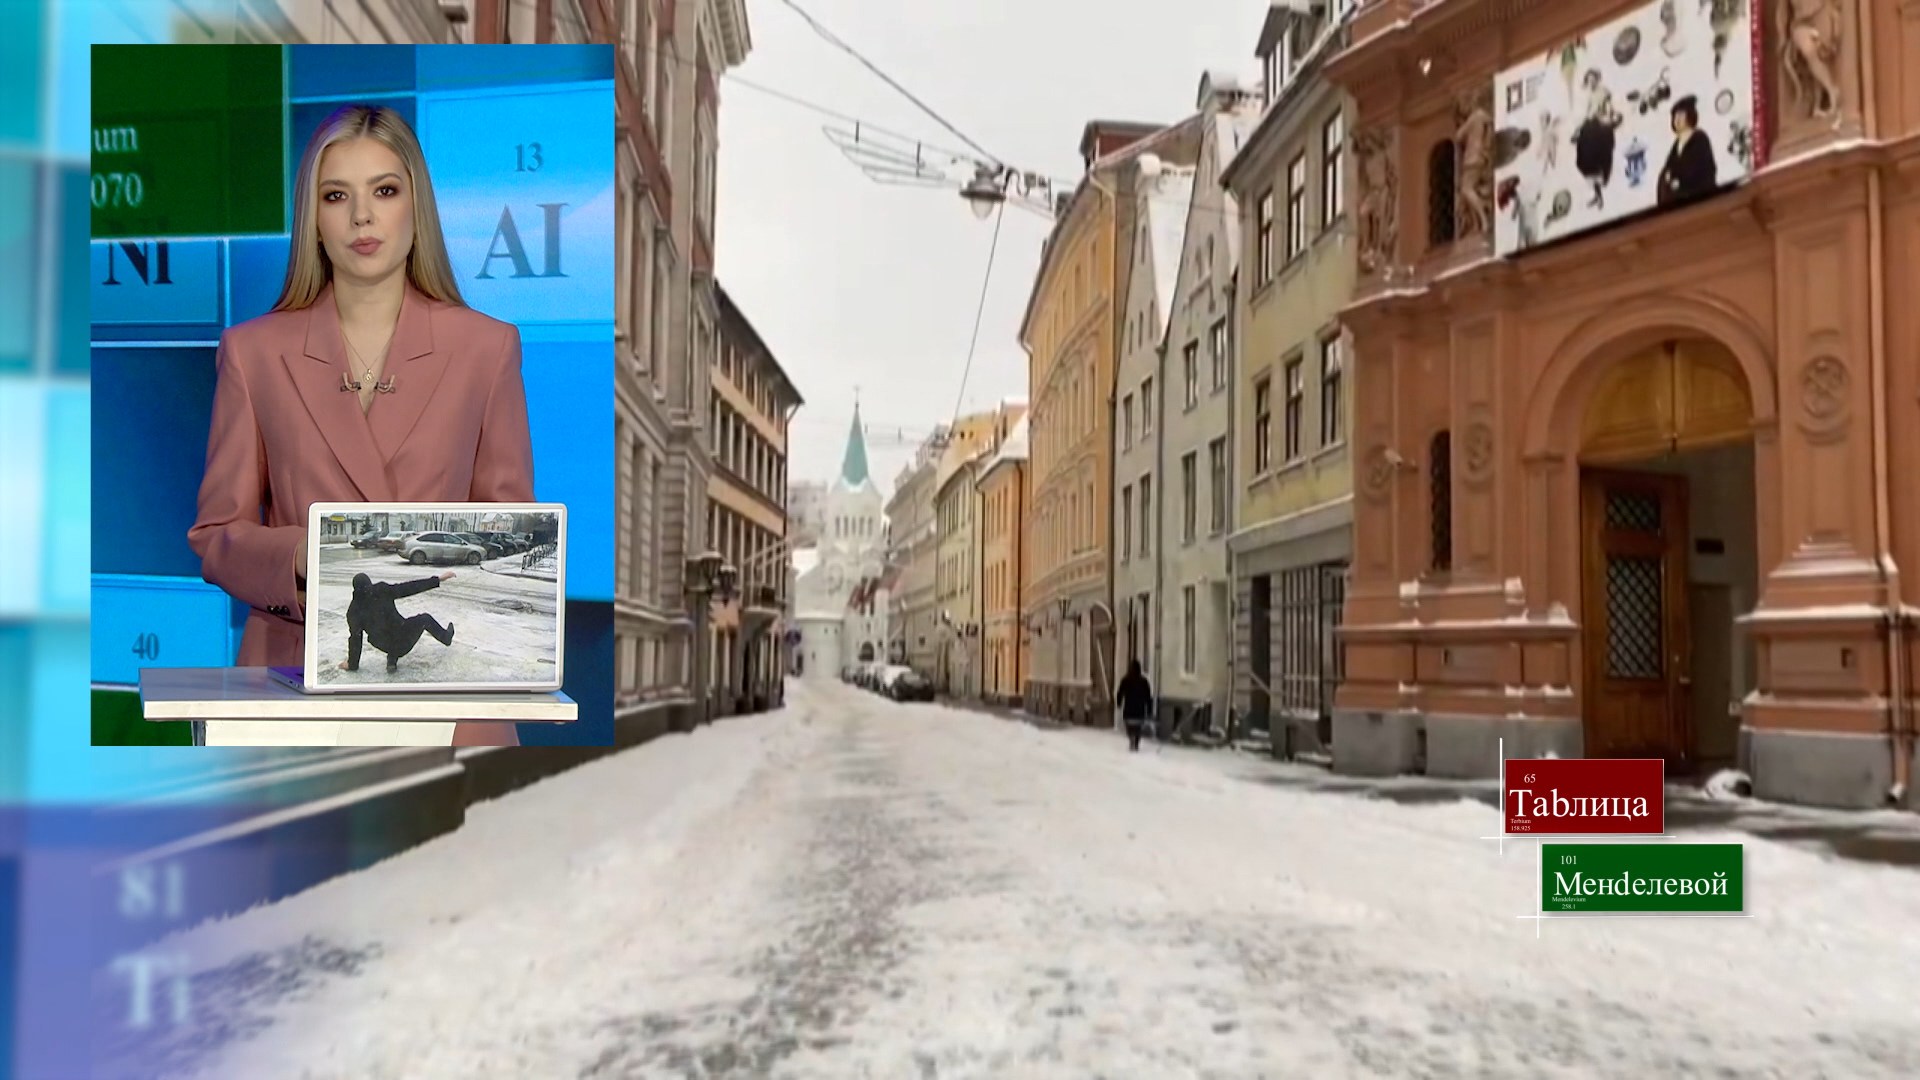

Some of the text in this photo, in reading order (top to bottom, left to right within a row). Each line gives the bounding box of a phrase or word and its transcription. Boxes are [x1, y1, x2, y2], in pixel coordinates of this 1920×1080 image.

[514, 141, 544, 172] 13
[91, 172, 143, 208] 070
[131, 631, 160, 661] 40
